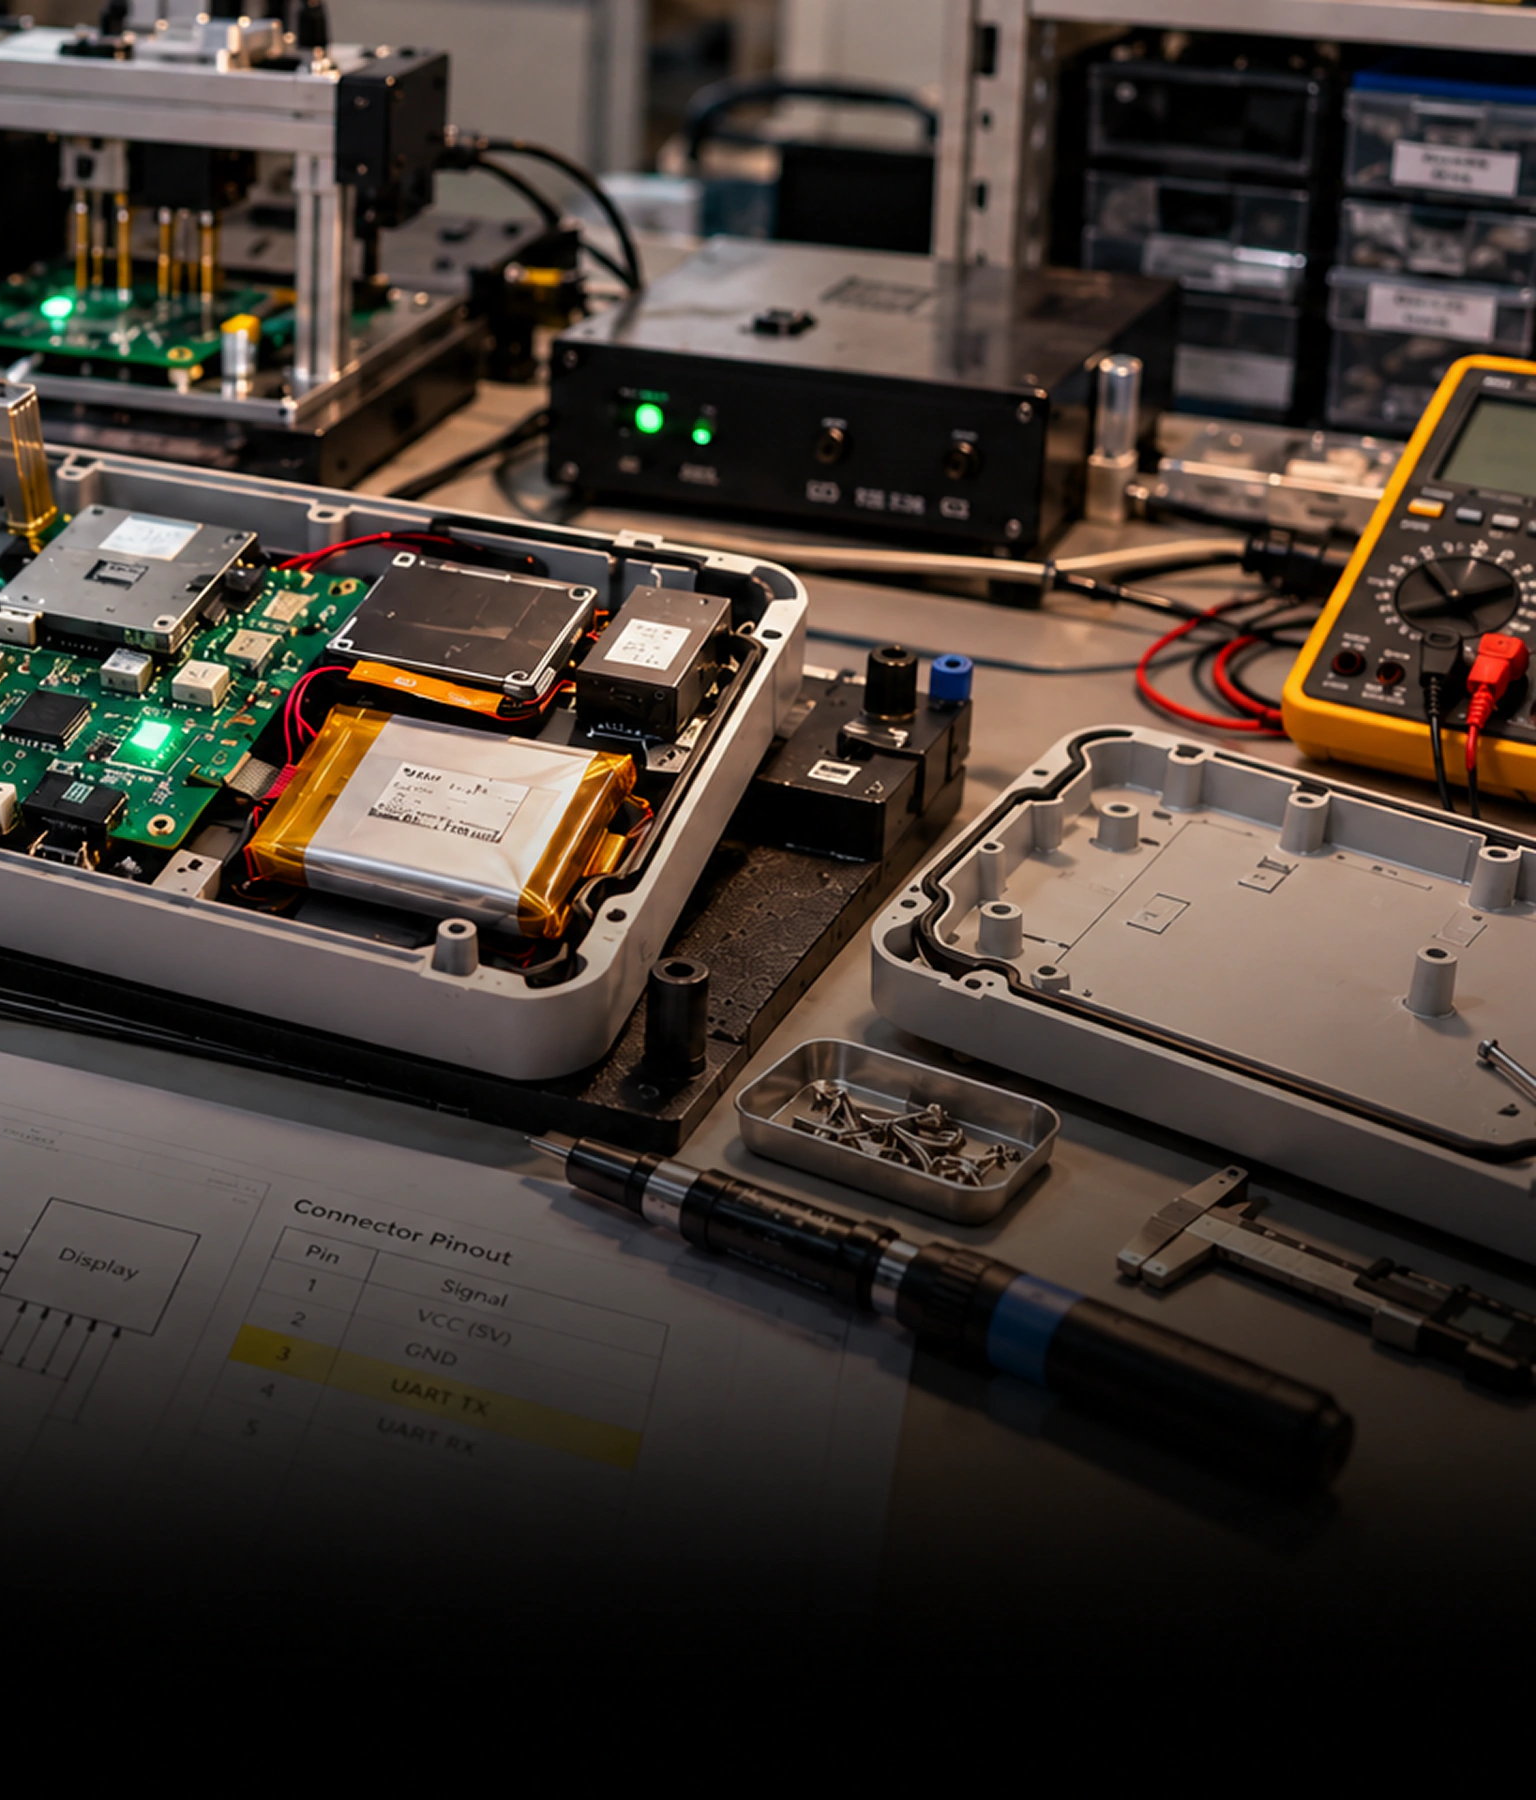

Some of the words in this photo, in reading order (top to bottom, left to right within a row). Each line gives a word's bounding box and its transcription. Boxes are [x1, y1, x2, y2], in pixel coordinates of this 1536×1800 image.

[293, 1198, 424, 1243] Connector
[428, 1231, 514, 1267] Pinout
[57, 1246, 140, 1282] Display
[305, 1243, 340, 1265] Pin
[307, 1278, 317, 1292] 1
[439, 1278, 509, 1308] Signal
[290, 1311, 307, 1328] 2
[416, 1307, 465, 1334] VCC
[275, 1346, 292, 1362] 3
[404, 1342, 459, 1368] GND
[390, 1377, 453, 1406] UART
[461, 1395, 492, 1418] TX
[376, 1416, 439, 1445] UART
